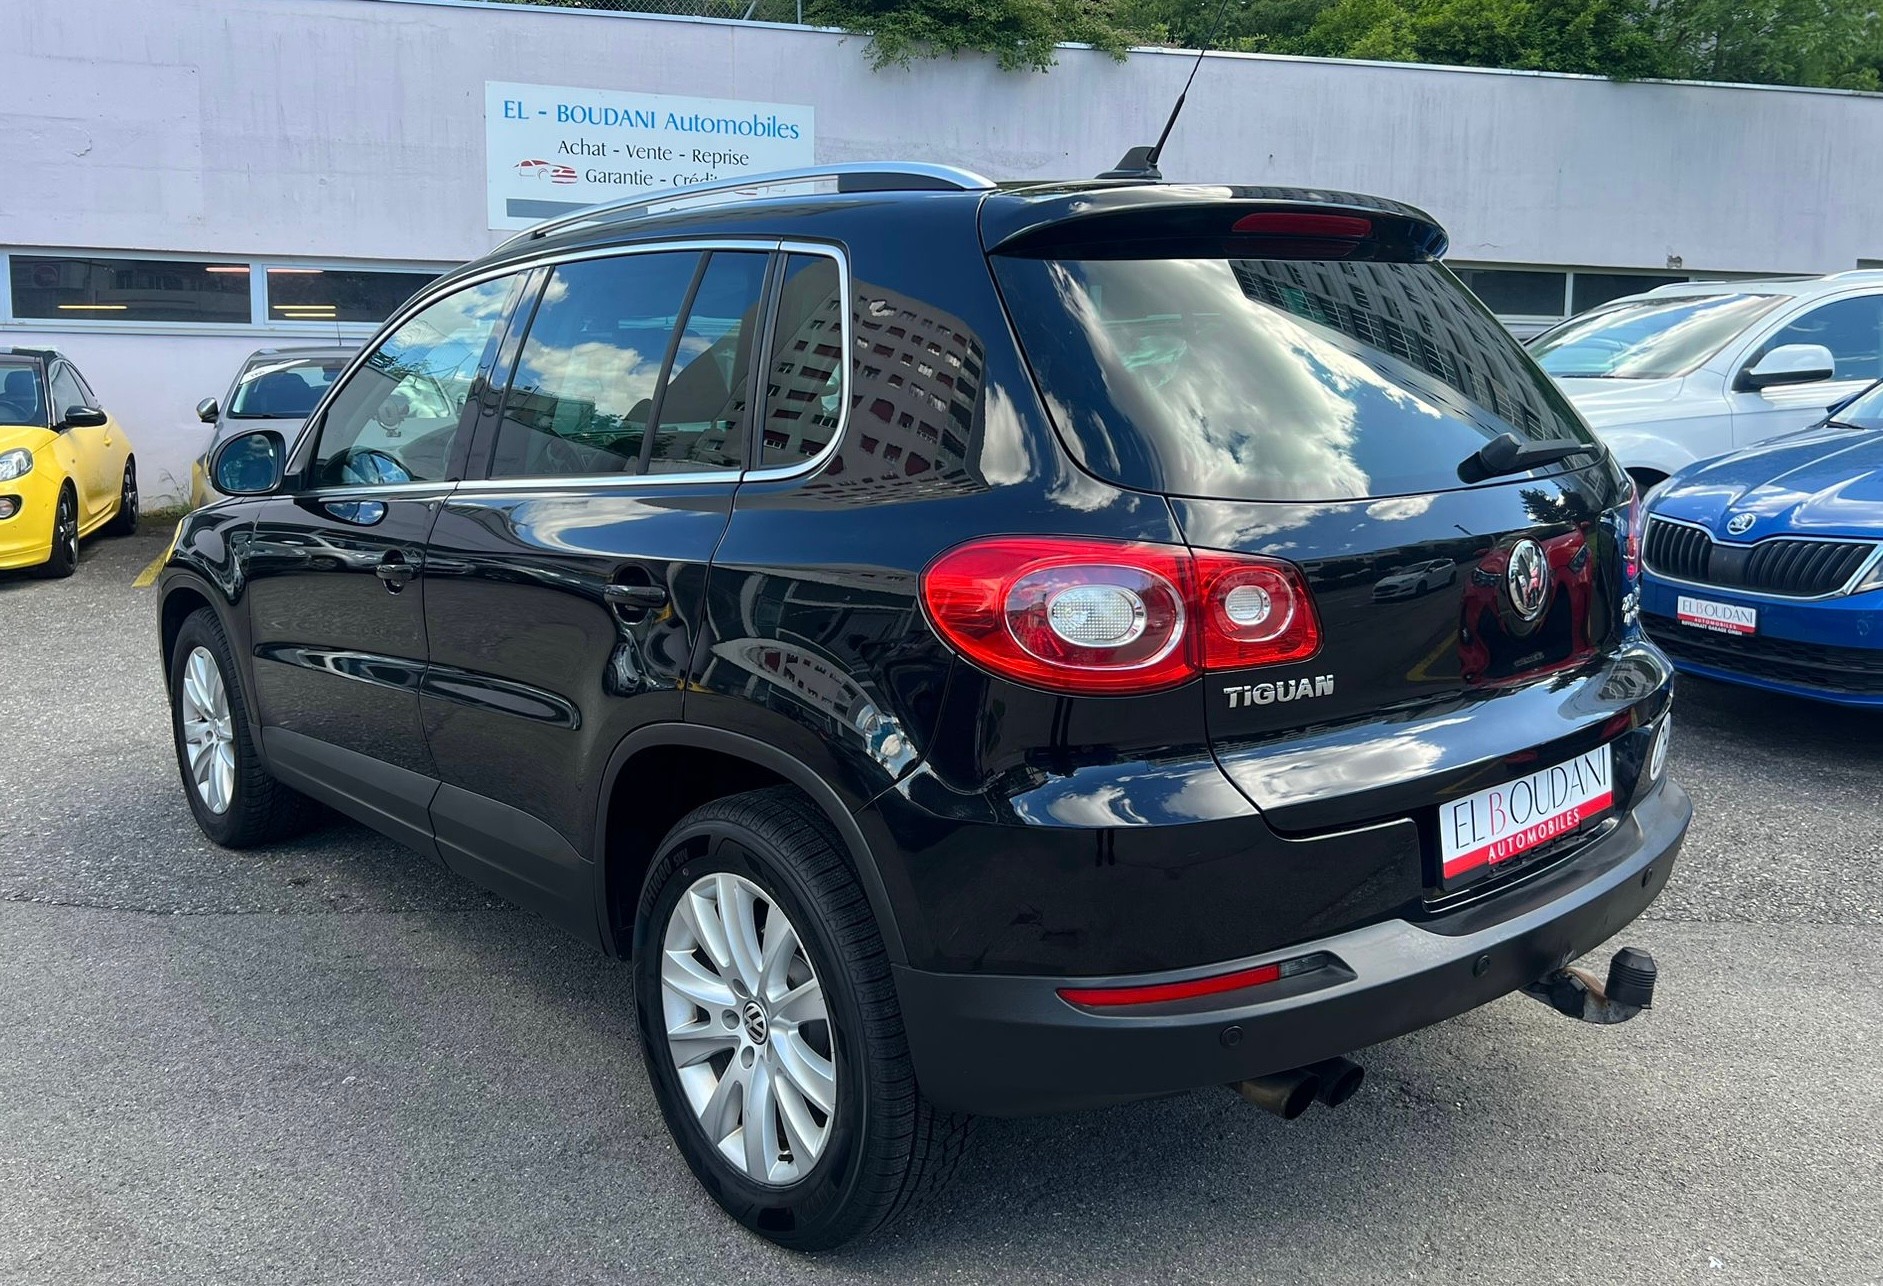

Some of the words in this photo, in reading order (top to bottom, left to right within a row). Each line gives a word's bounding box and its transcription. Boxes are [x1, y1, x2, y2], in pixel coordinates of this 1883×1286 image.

[503, 100, 529, 120] EL
[556, 104, 655, 129] BOUDANI
[664, 112, 799, 139] Automobiles
[558, 138, 607, 157] Achat
[626, 144, 673, 161] Vente
[692, 149, 750, 169] Reprise
[585, 168, 653, 186] Garantie
[1694, 617, 1737, 629] AUTOMOBILES
[1488, 809, 1581, 862] AUTOMOBILES
